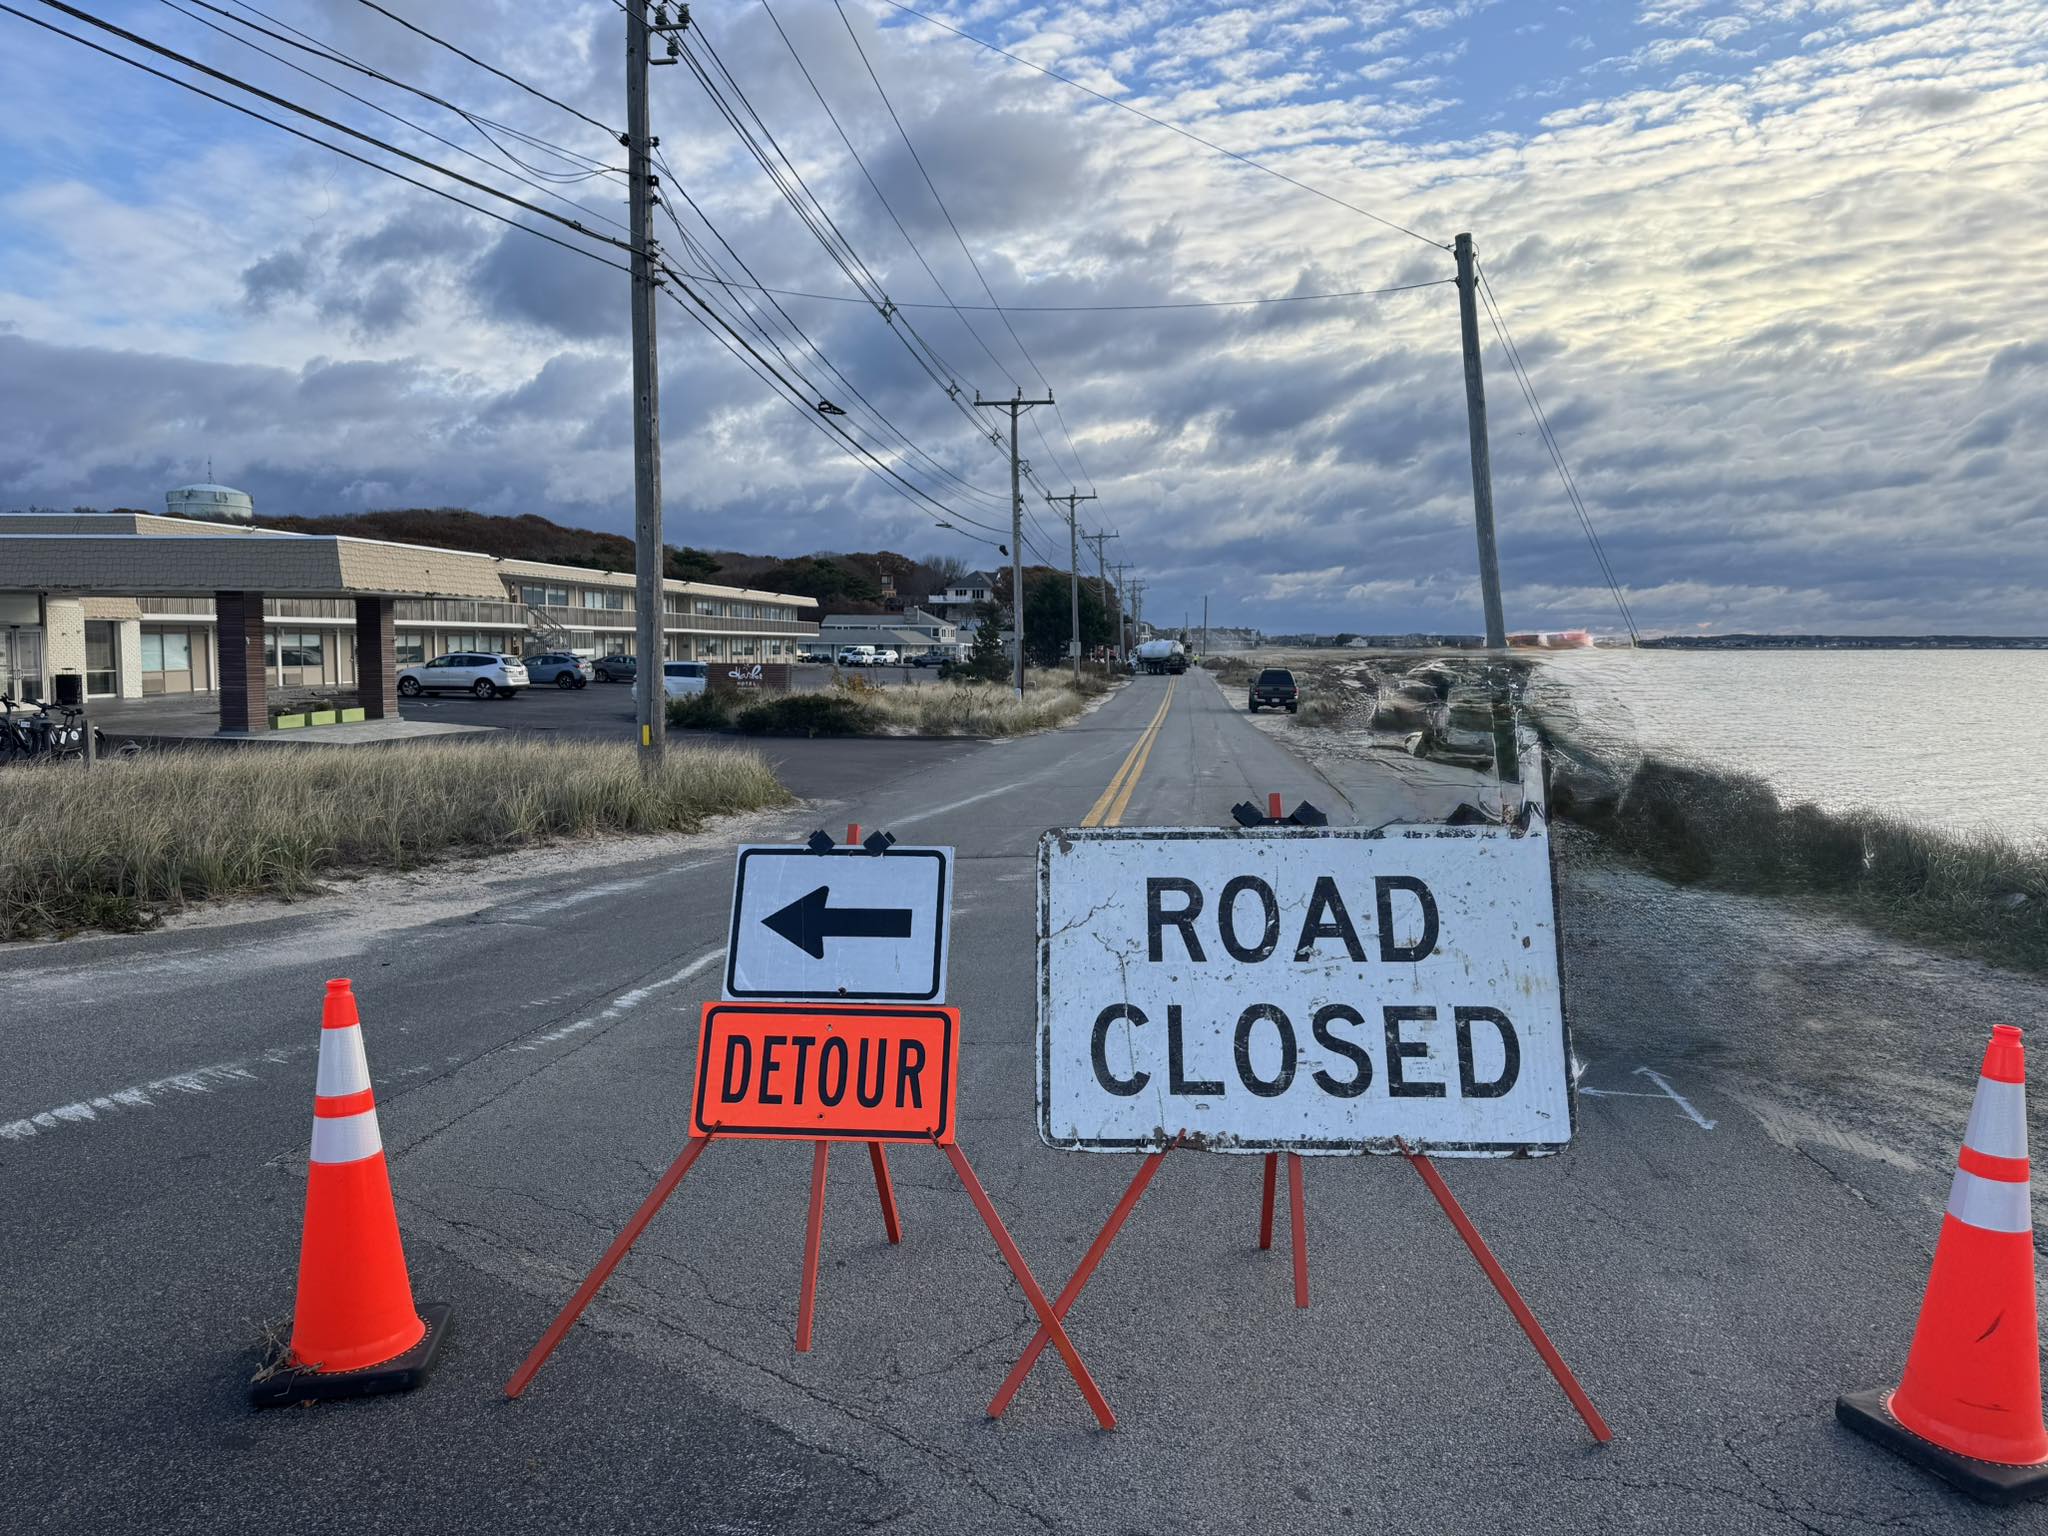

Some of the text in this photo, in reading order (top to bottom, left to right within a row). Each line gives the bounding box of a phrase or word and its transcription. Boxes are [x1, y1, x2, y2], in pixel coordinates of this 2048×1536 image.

[1147, 875, 1439, 964] ROAD
[721, 1035, 925, 1109] DETOUR
[1090, 1003, 1521, 1098] CLOSED
